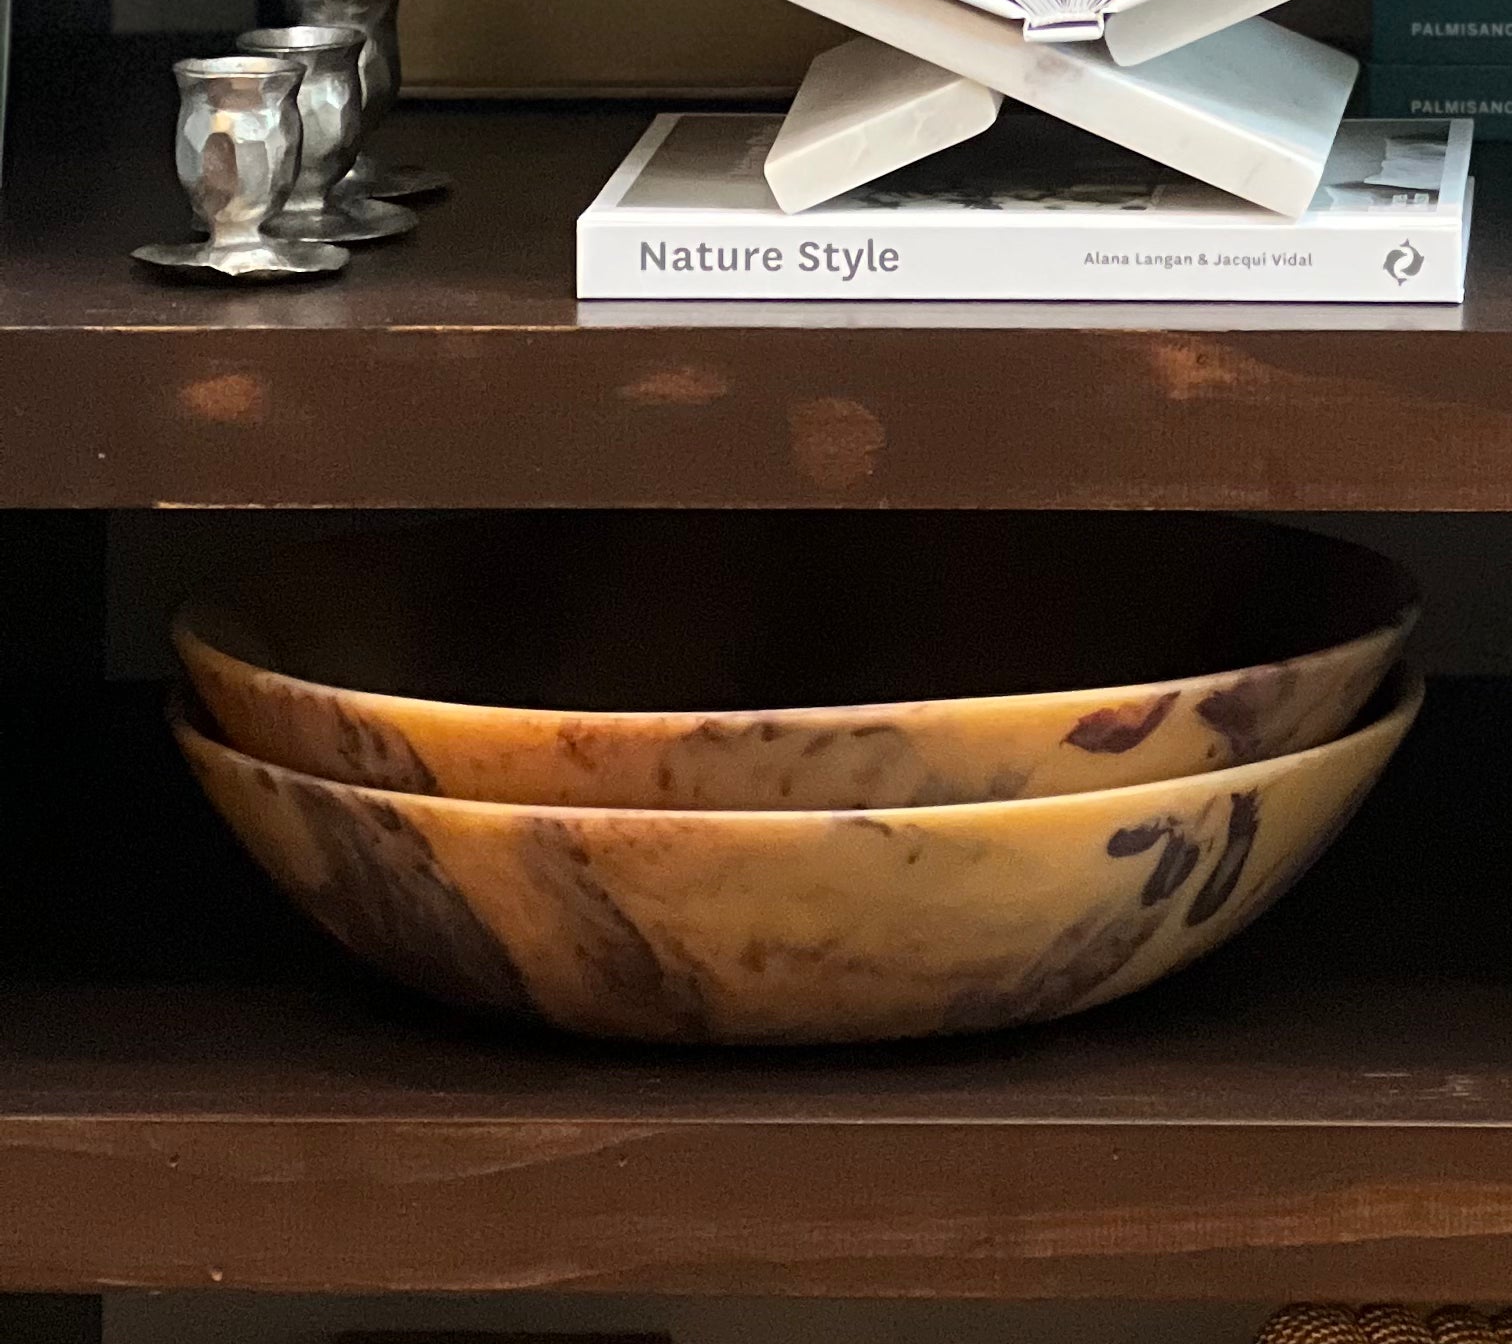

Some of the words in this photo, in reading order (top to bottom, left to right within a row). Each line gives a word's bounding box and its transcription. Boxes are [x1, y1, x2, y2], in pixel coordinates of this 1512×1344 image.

[640, 240, 783, 273] Nature
[798, 238, 900, 282] Style
[1083, 251, 1130, 267] Alana
[1135, 252, 1193, 270] Langan
[1198, 253, 1209, 267] &
[1213, 251, 1267, 271] Jacqui
[1273, 252, 1313, 268] Vidal
